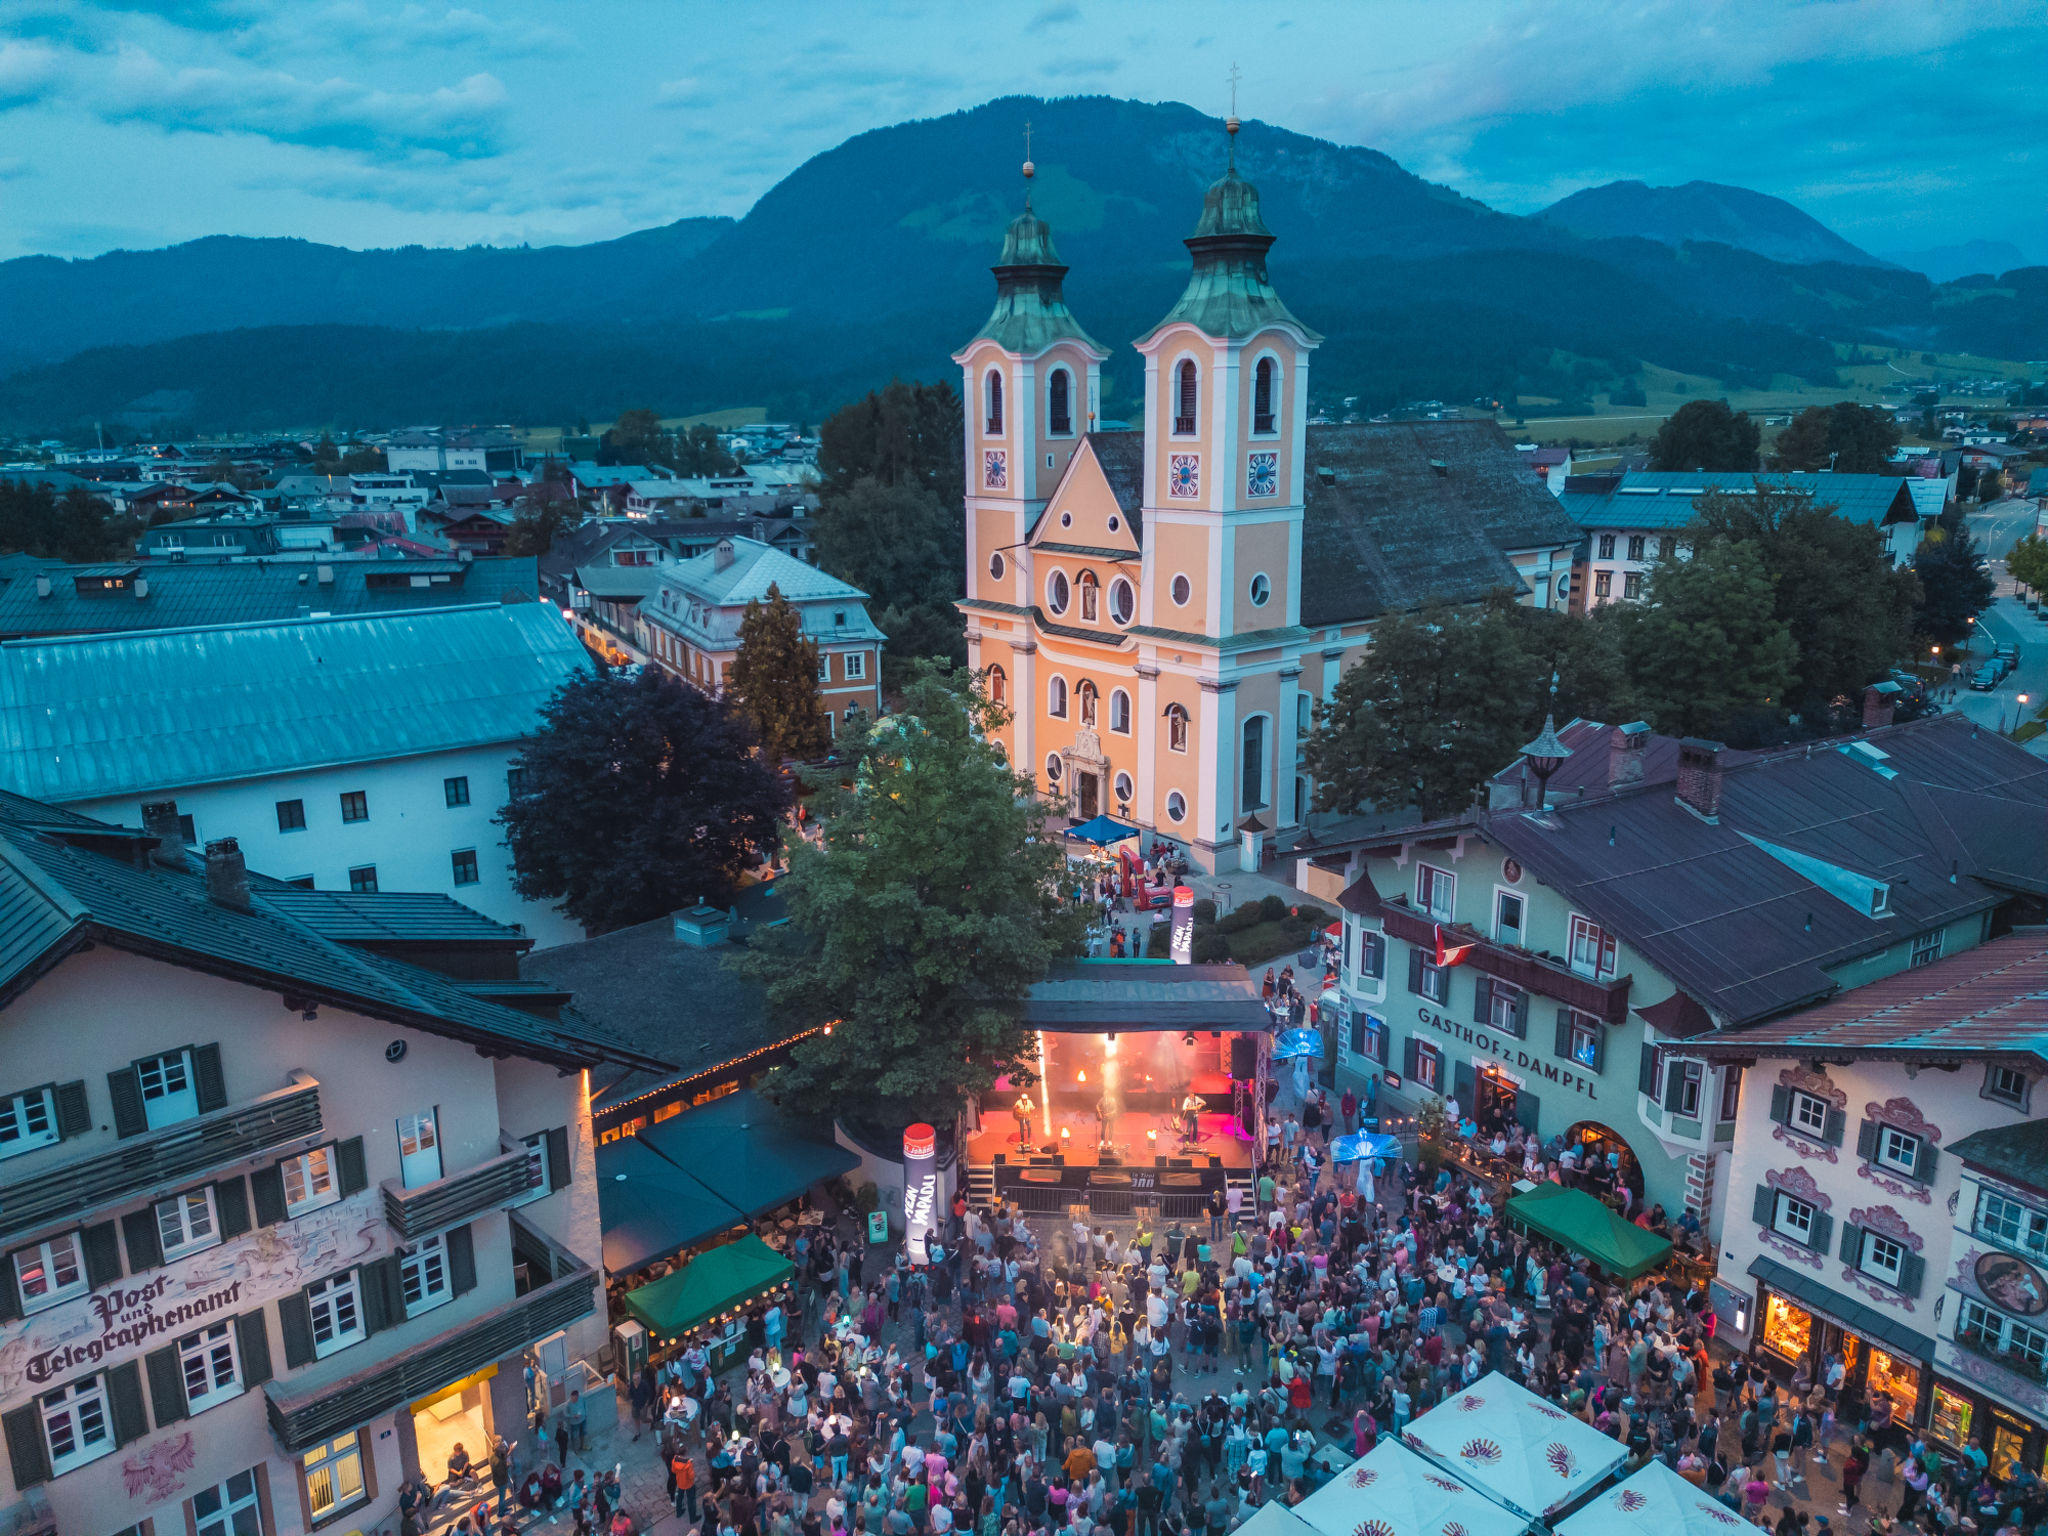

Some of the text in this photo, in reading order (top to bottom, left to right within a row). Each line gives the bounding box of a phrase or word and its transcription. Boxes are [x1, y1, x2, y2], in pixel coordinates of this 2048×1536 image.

[1418, 1008, 1500, 1055] GASTHOF
[1518, 1051, 1598, 1101] DAMPFL
[25, 1280, 242, 1384] Telegraphenamt
[120, 1303, 153, 1323] und
